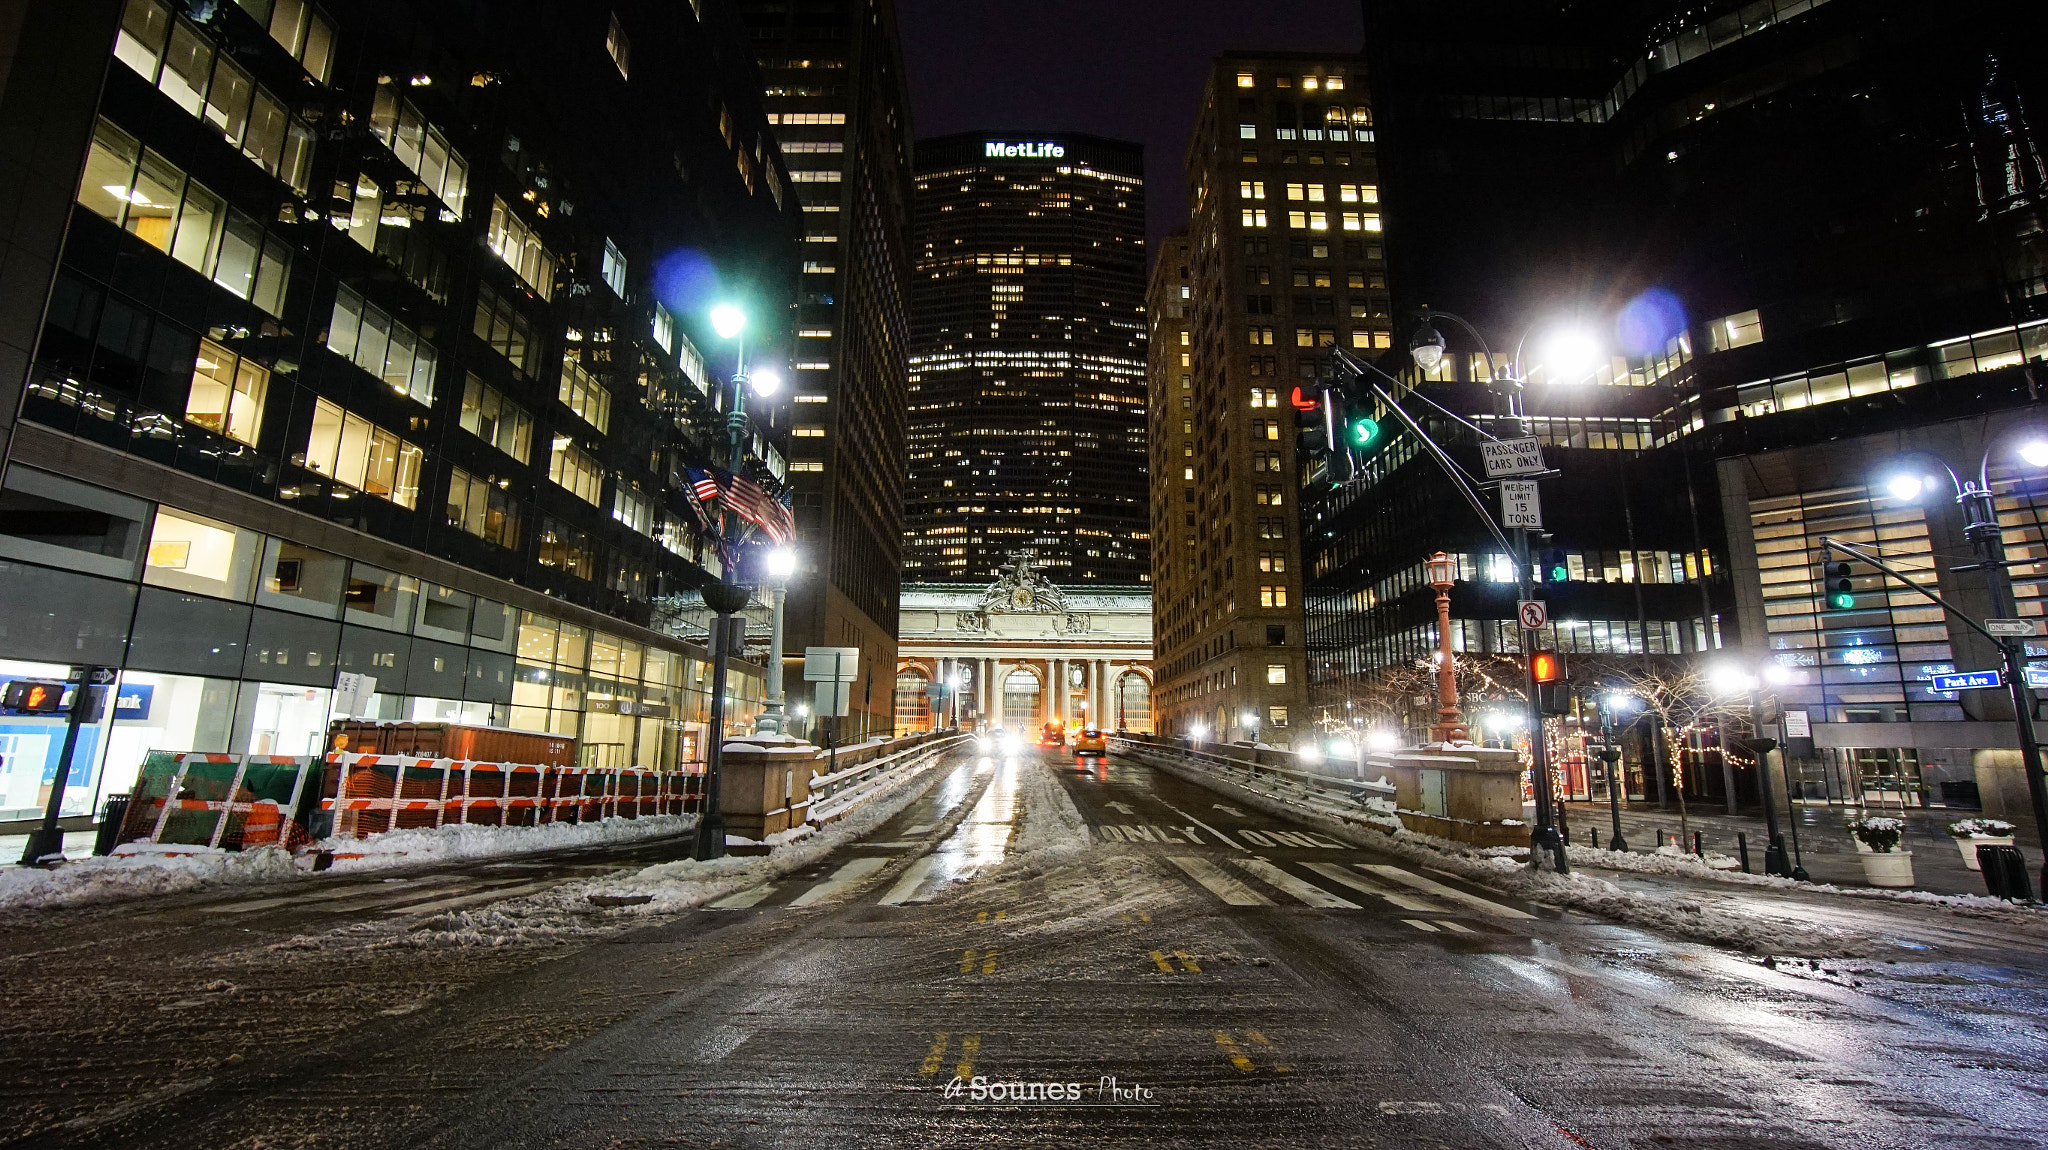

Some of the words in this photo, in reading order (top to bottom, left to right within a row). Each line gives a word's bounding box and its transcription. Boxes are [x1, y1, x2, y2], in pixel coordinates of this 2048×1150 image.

[985, 142, 1065, 158] MetLife
[1485, 441, 1537, 457] PASSENGER
[1489, 458, 1512, 471] CARS
[1516, 455, 1539, 468] ONLY
[1503, 483, 1535, 491] WEIGHT
[1509, 493, 1531, 501] LIMIT
[1515, 502, 1528, 512] 15
[1508, 514, 1537, 524] TONS
[2014, 623, 2029, 631] WAY
[95, 671, 110, 680] WAY
[1944, 676, 1967, 687] Park
[1969, 675, 1989, 686] Ave
[595, 702, 609, 710] 100
[1100, 825, 1206, 845] ONLY
